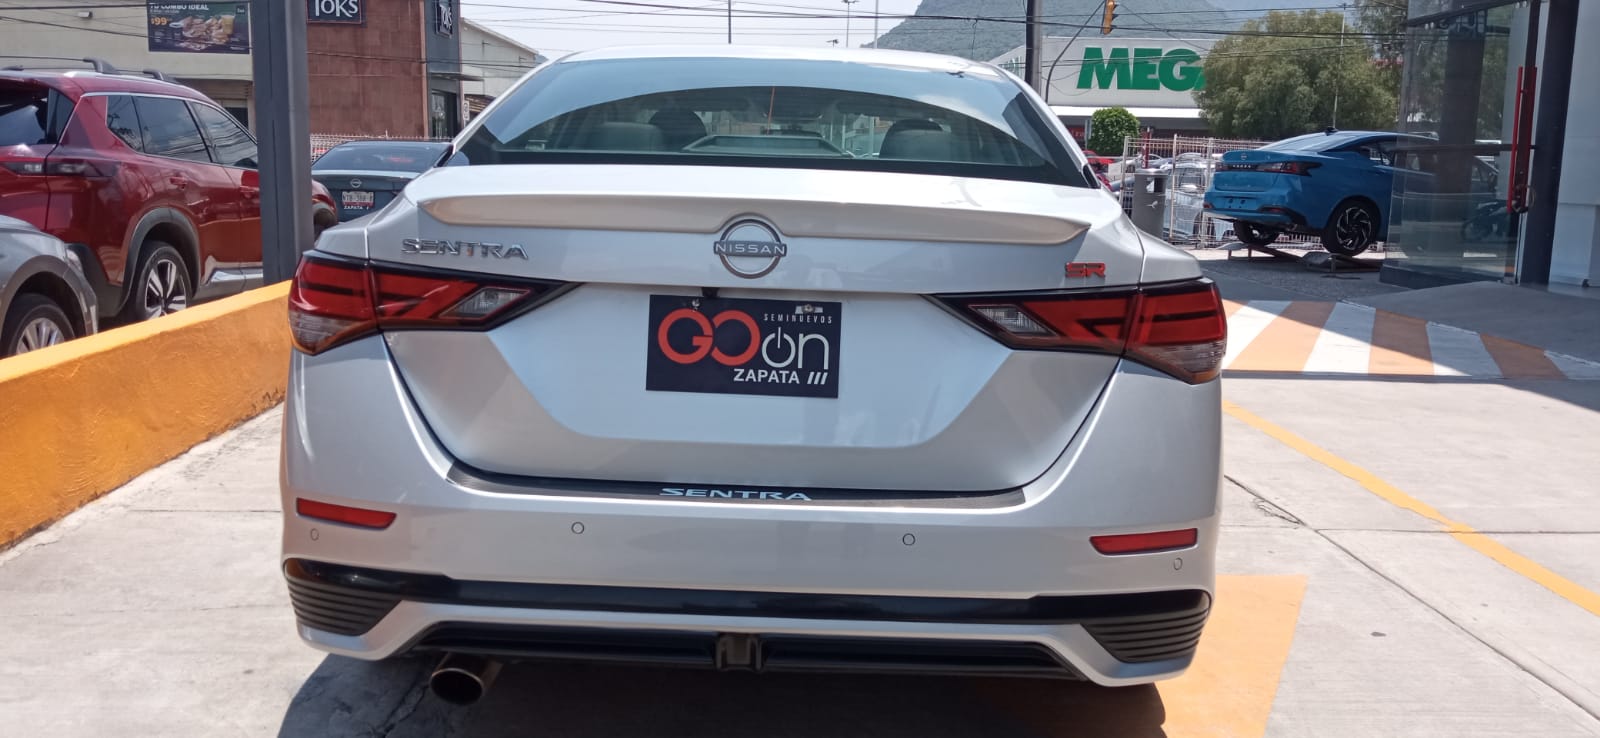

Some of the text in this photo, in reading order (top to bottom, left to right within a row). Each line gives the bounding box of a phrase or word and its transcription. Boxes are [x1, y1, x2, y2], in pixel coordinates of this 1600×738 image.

[1077, 47, 1207, 91] MEG
[401, 238, 529, 260] SENTRA
[715, 242, 786, 255] NISSAN
[1065, 262, 1105, 278] SR
[764, 313, 832, 325] SEMINUEVOS
[734, 368, 800, 385] ZAPATA
[659, 488, 812, 501] SENTRA
